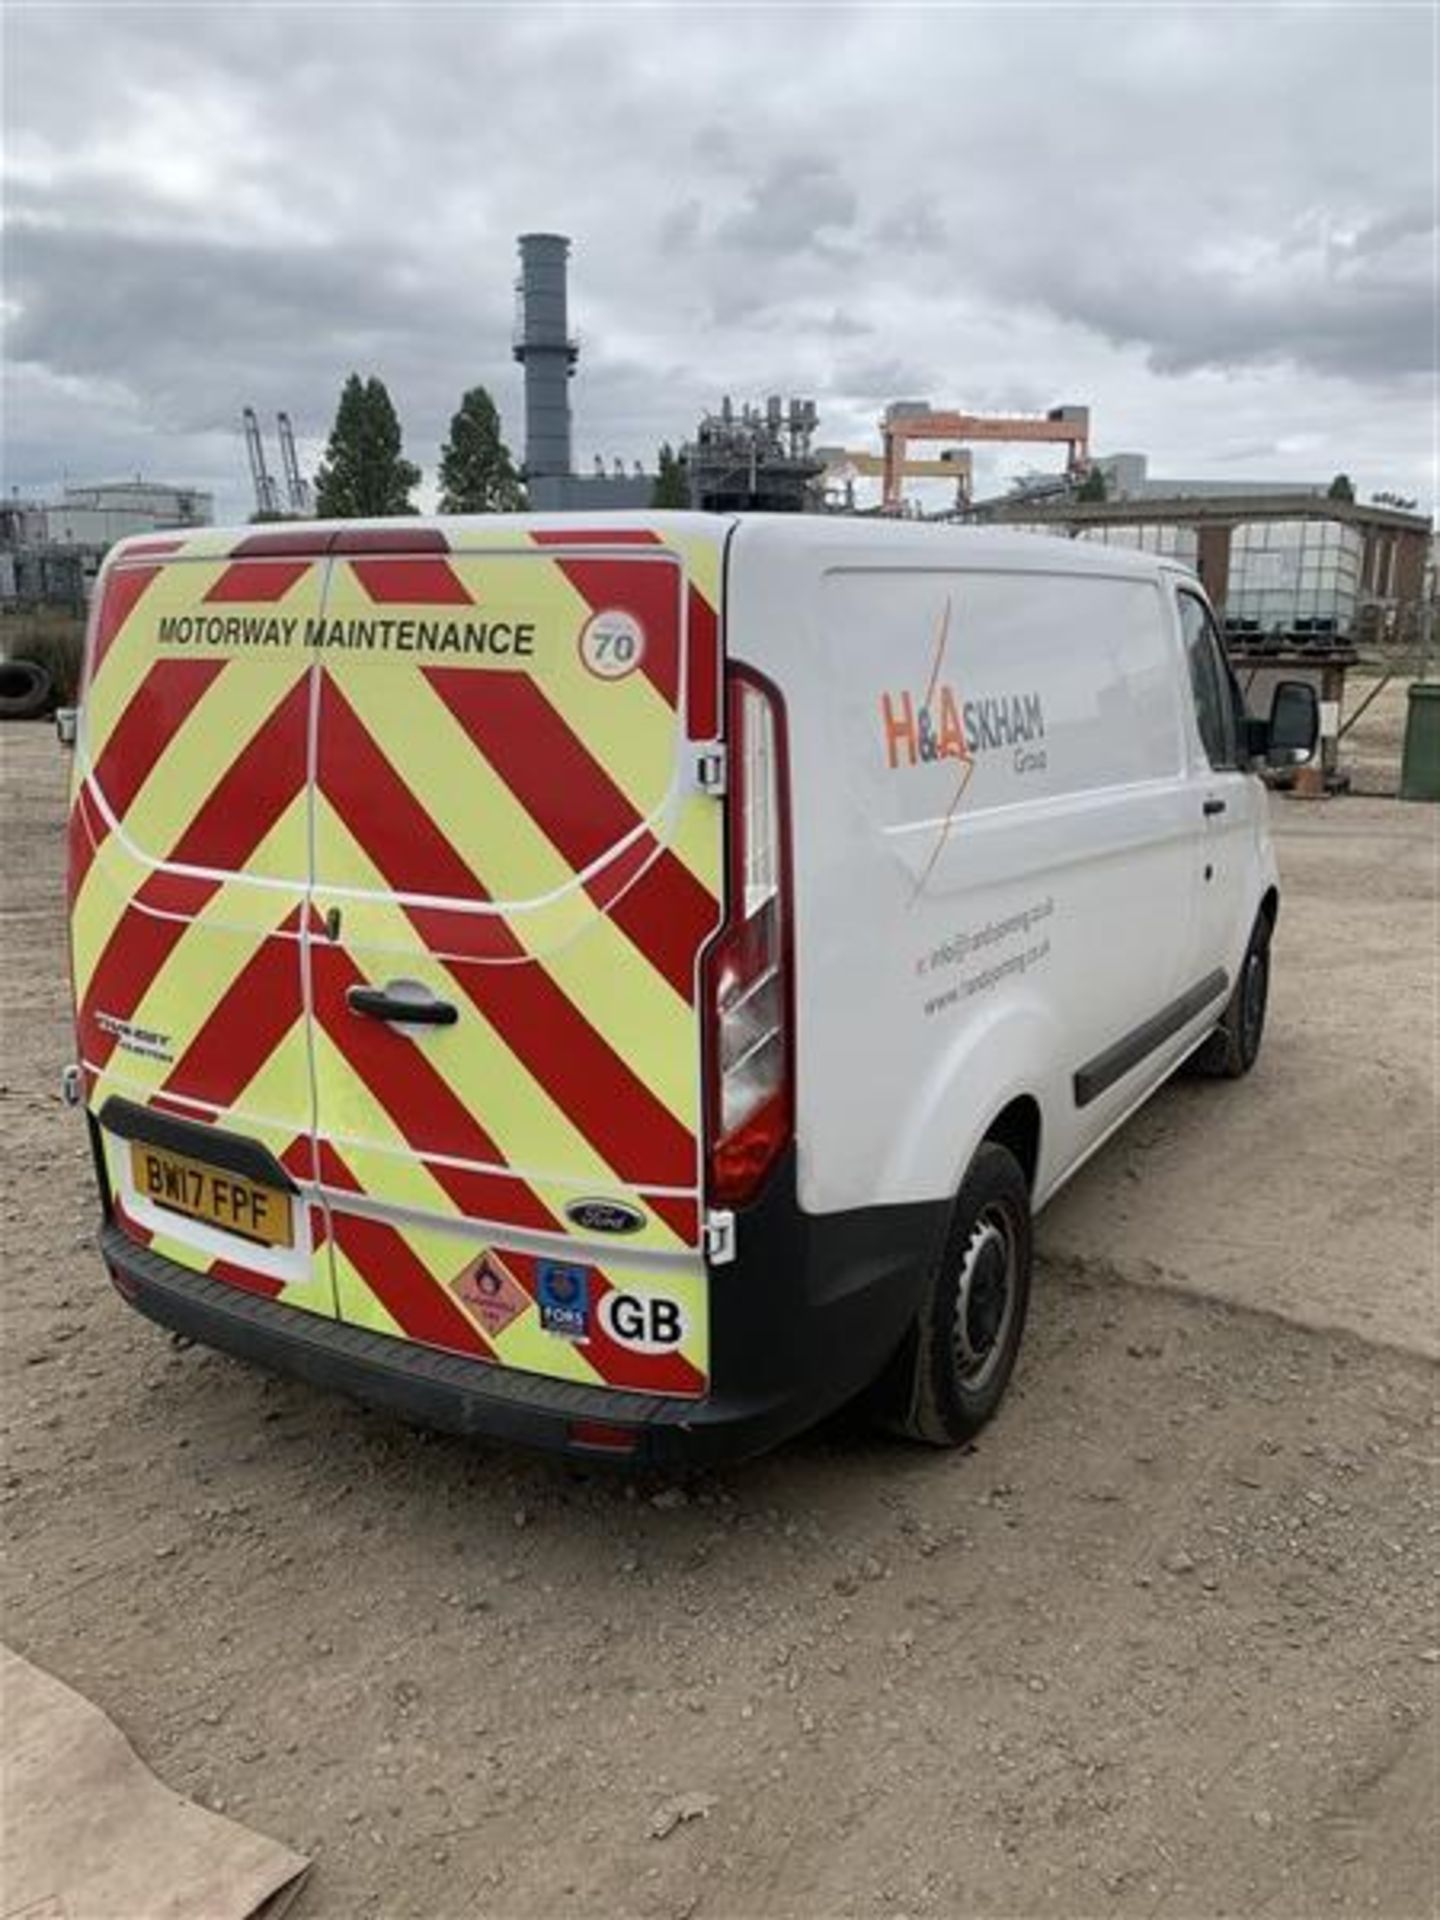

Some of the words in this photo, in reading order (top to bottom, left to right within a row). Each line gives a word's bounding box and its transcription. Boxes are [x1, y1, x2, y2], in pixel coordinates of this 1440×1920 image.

[158, 616, 297, 645] MOTORWAY
[303, 618, 535, 656] MAINTENANCE
[592, 632, 635, 663] 70
[211, 1178, 268, 1229] FPF
[610, 1294, 683, 1344] GB
